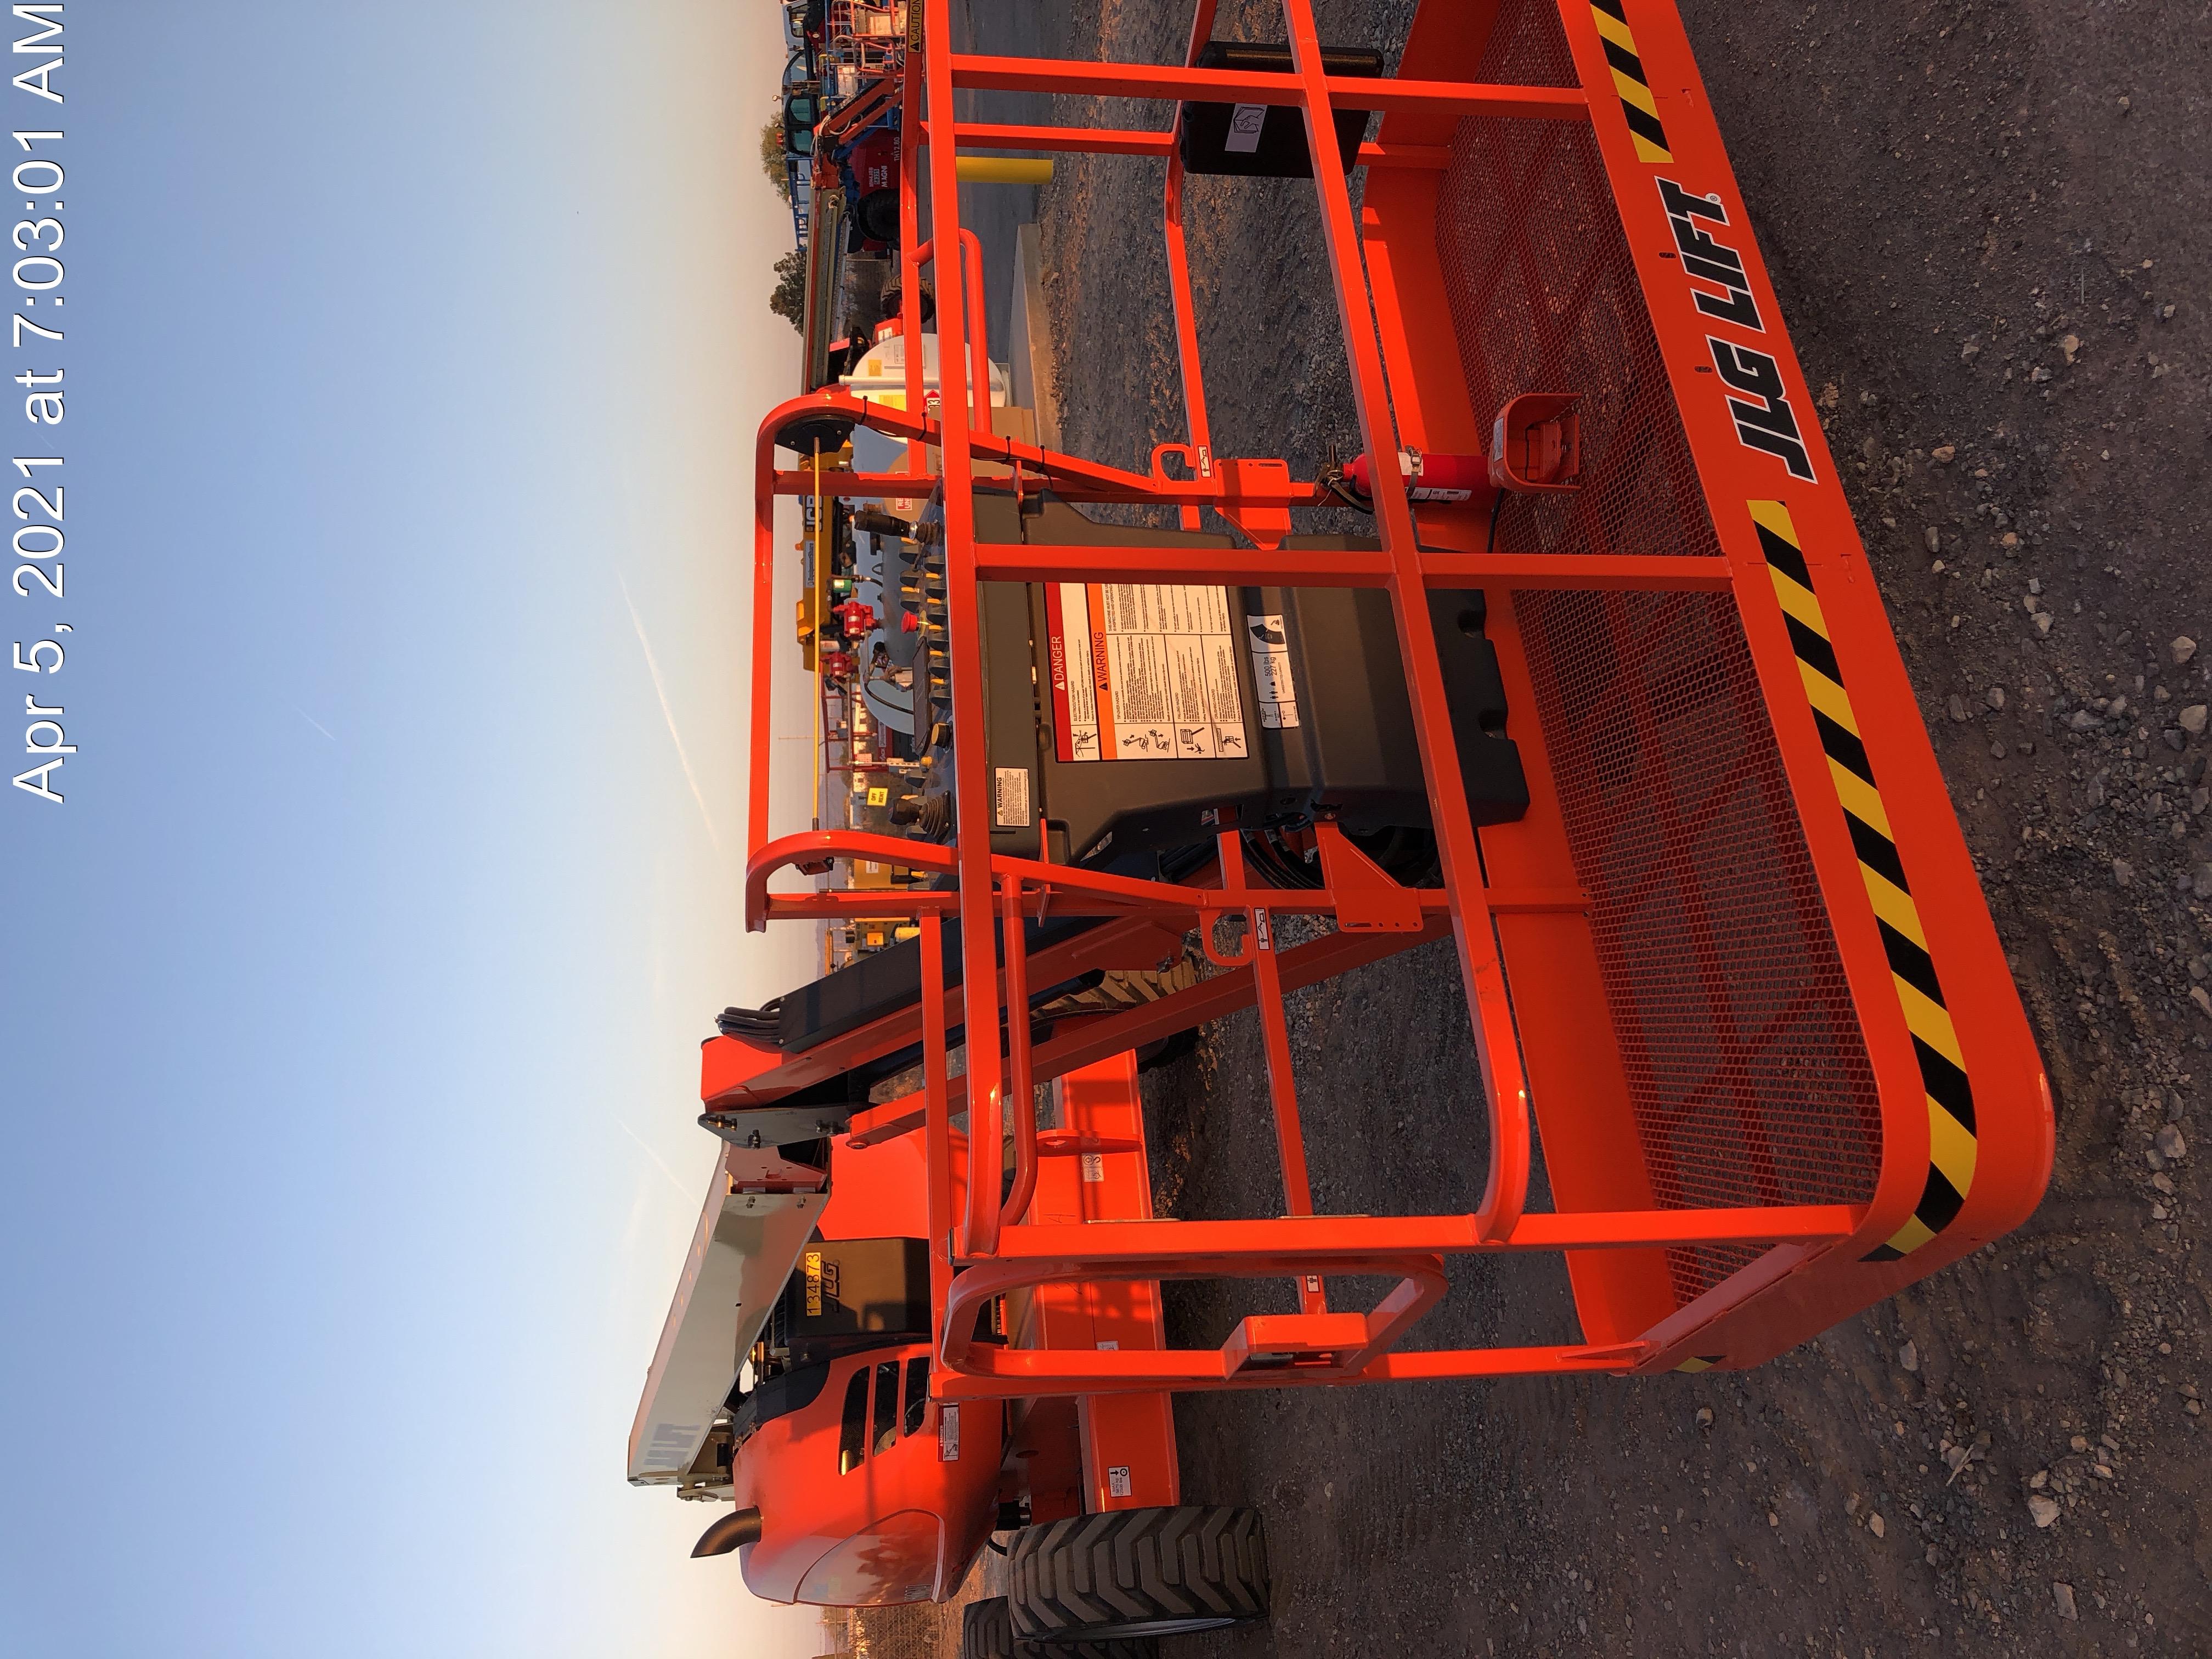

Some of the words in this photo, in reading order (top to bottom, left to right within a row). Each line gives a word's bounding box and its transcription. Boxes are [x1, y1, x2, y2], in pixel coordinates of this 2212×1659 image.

[911, 0, 921, 41] CAUTION
[1654, 176, 1767, 334] LIFT
[1705, 334, 1819, 484] JLG
[1051, 636, 1064, 680] DANGER
[1093, 632, 1107, 681] WARNING
[806, 1254, 820, 1313] 134873
[821, 1260, 840, 1313] JLG
